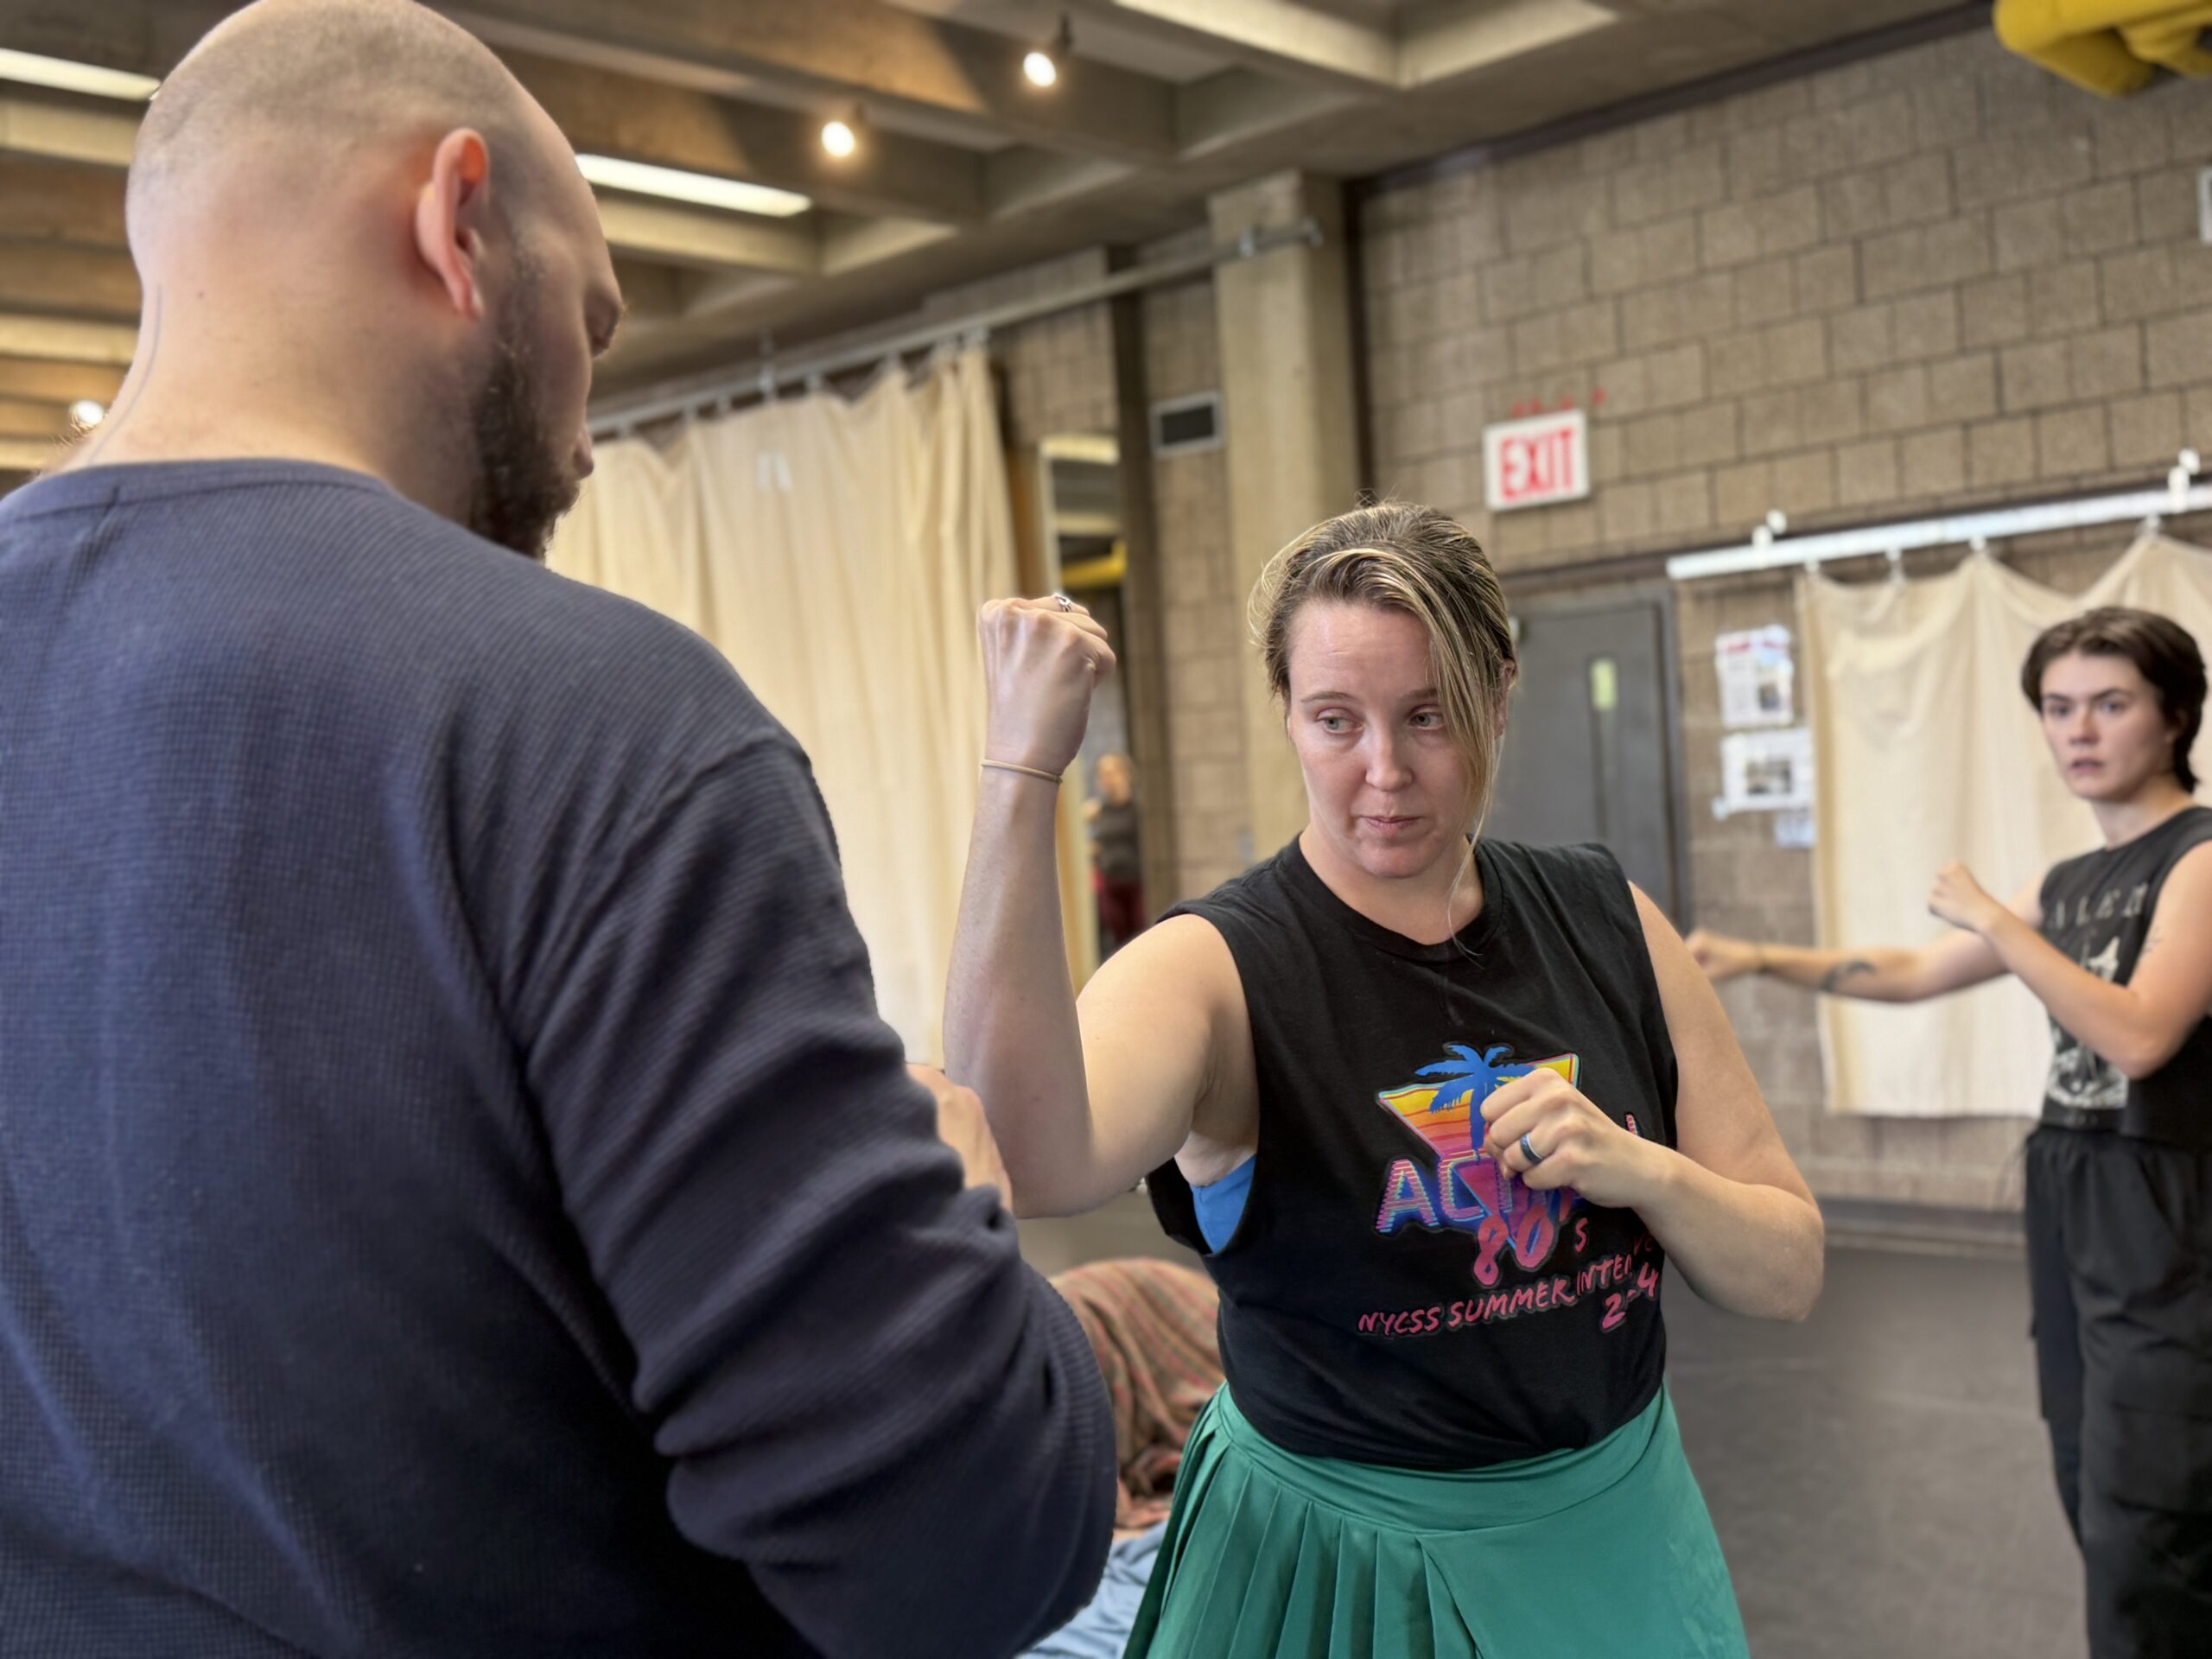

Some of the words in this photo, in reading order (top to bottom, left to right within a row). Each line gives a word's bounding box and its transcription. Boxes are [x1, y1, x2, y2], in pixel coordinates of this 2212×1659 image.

[1500, 429, 1573, 501] EXIT
[1357, 1306, 1441, 1336] NYCSS
[1448, 1278, 1575, 1328] SUMMER
